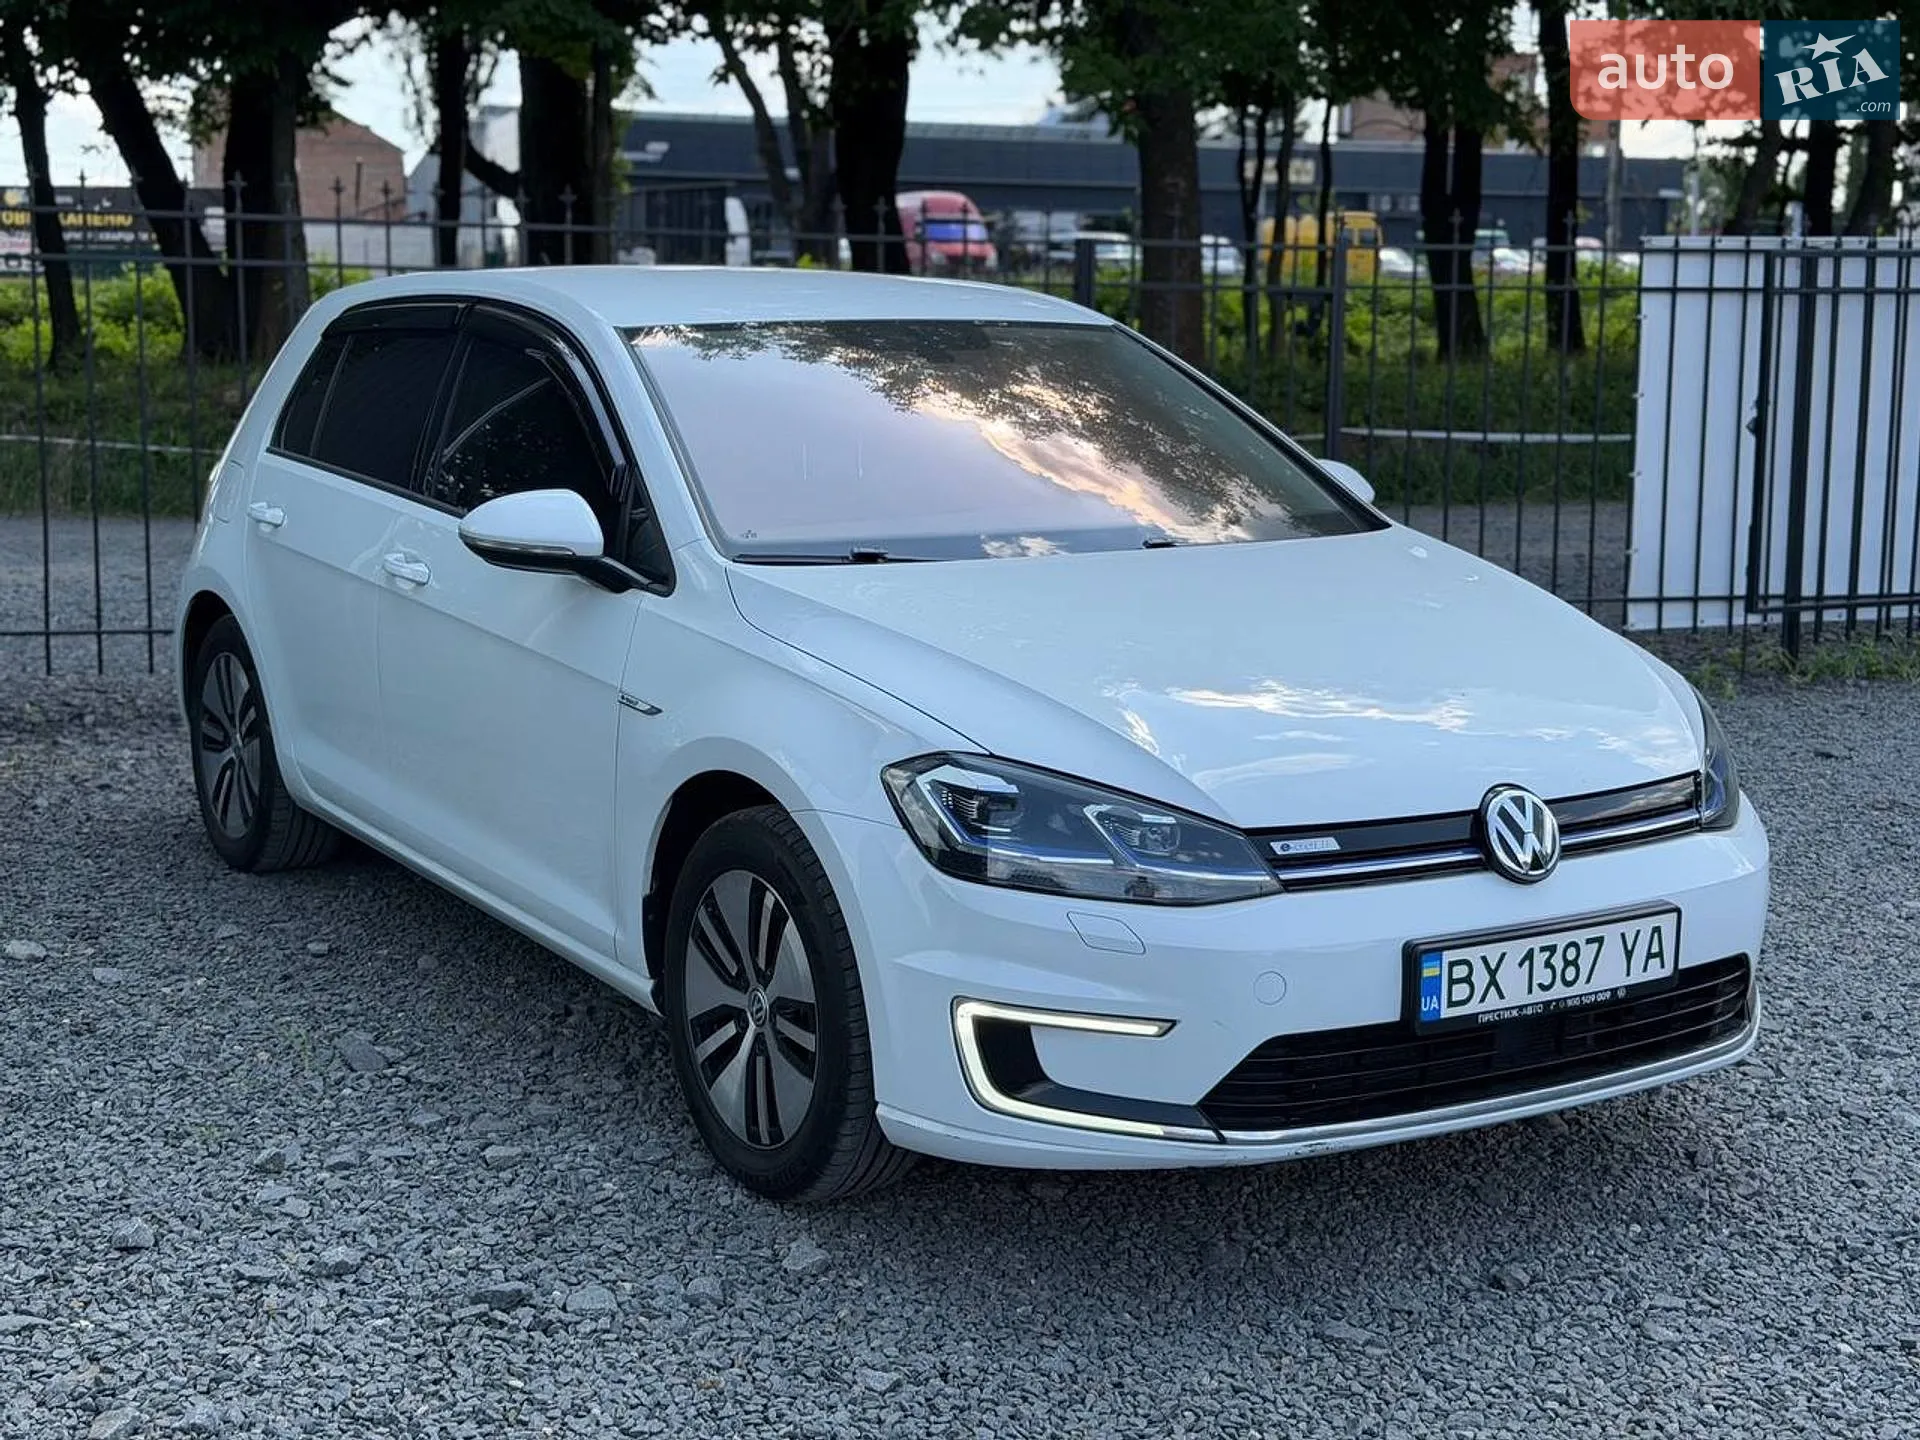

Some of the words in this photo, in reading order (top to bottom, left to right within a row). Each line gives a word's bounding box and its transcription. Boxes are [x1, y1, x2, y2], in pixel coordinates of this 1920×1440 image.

[1447, 952, 1507, 1009] BX
[1517, 936, 1605, 995] 1387
[1620, 926, 1666, 977] YA
[1421, 995, 1440, 1012] UA
[1478, 1003, 1544, 1024] ПРЕСТИЖ-АВТО
